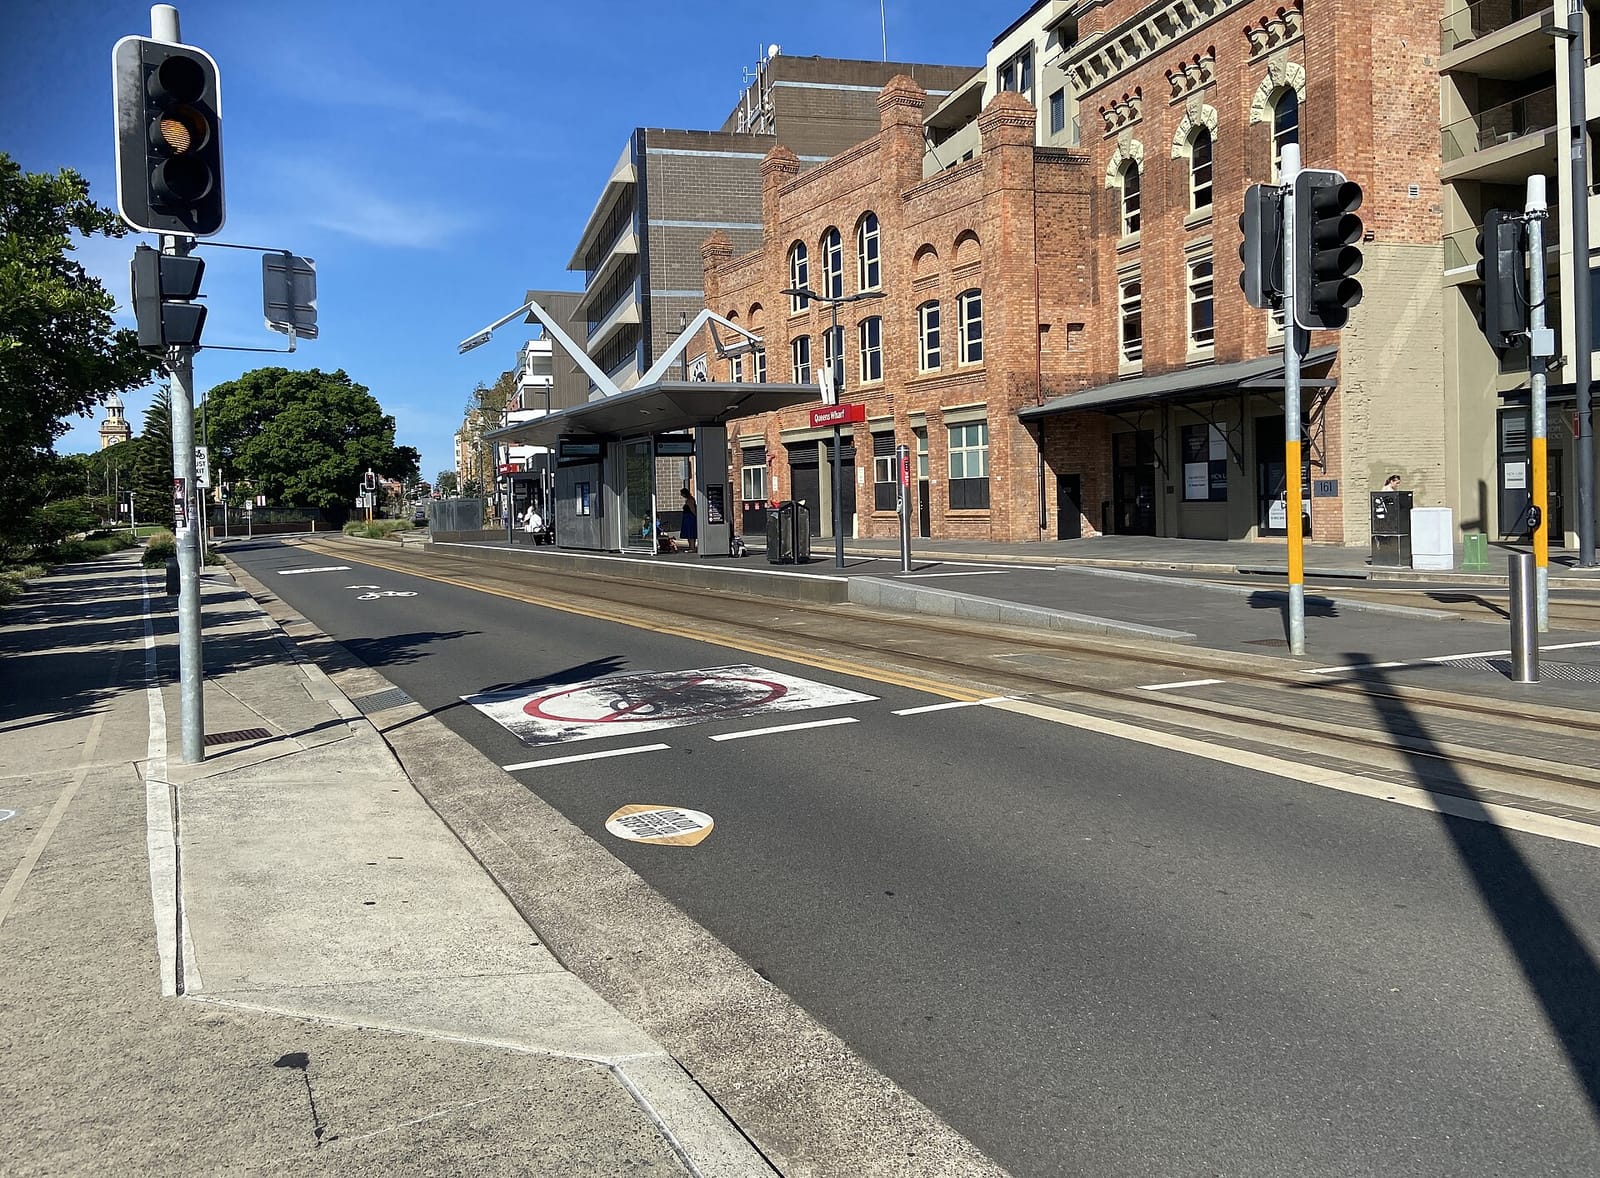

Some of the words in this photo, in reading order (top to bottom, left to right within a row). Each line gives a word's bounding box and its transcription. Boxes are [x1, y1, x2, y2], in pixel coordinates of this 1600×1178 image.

[814, 413, 831, 424] Queens
[830, 408, 845, 420] Wharf
[1320, 481, 1332, 492] 161
